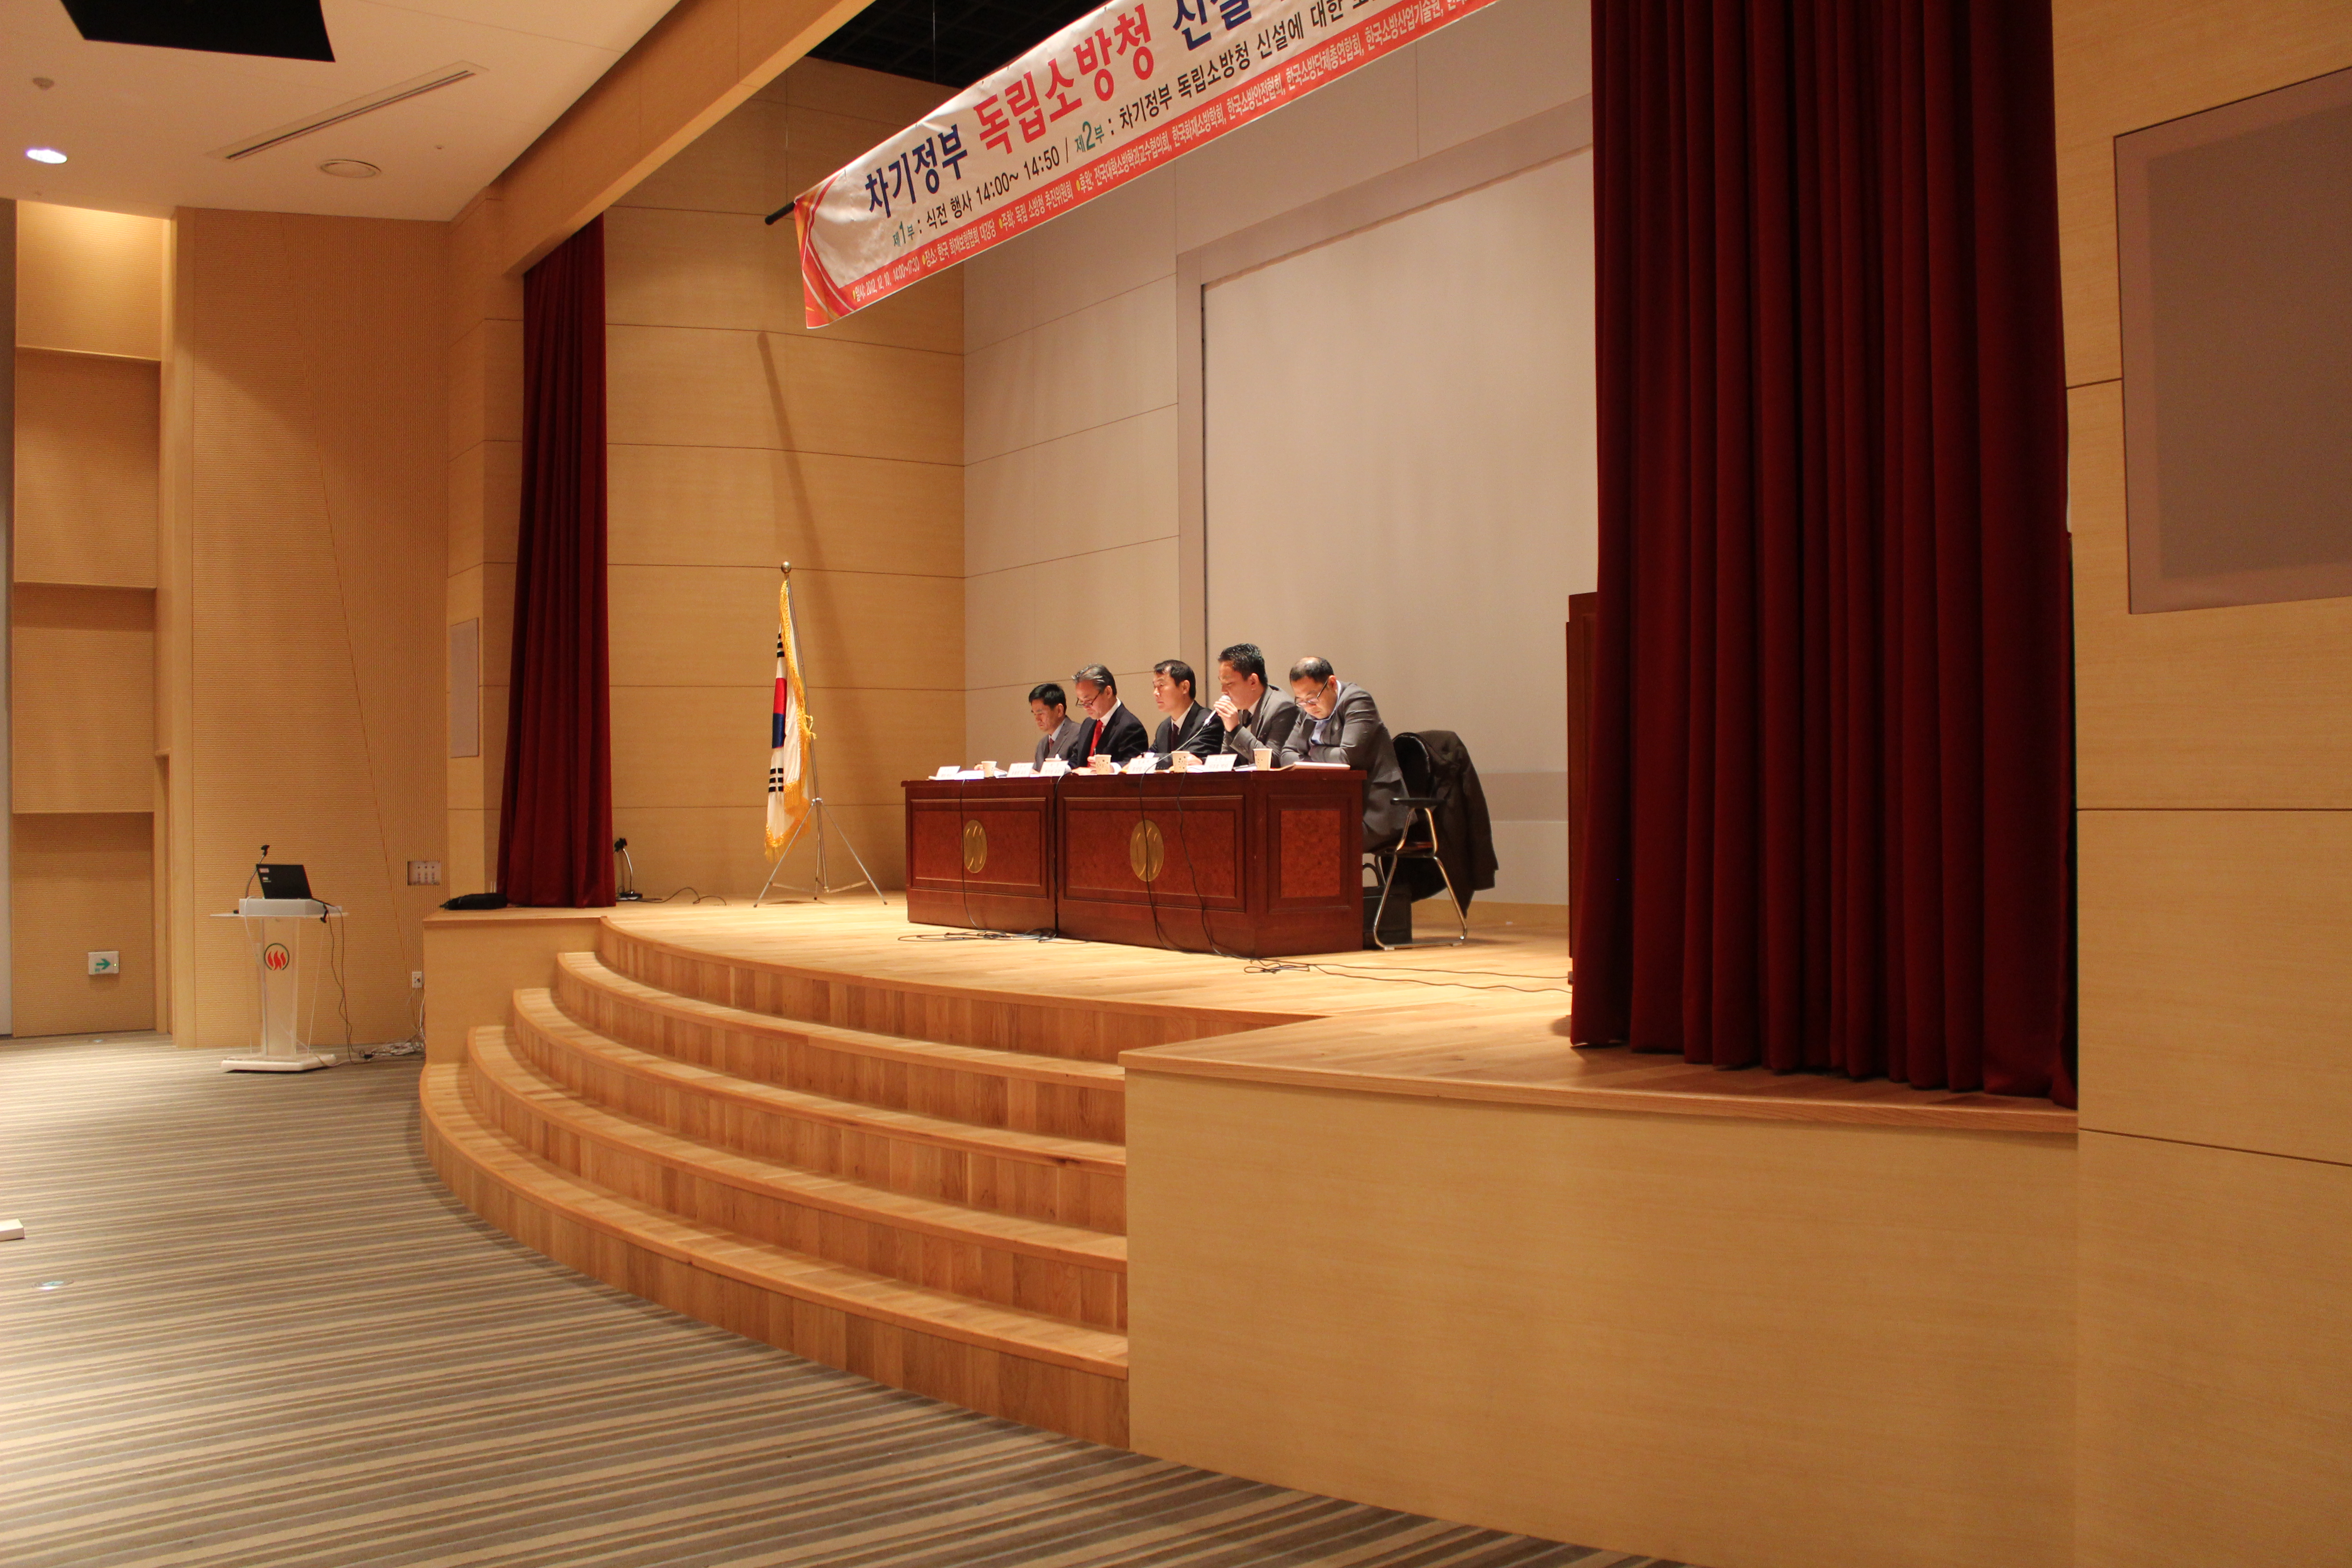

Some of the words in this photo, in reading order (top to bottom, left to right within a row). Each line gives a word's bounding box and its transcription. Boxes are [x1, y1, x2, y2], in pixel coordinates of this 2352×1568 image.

[865, 123, 968, 218] 차기정부
[973, 3, 1154, 154] 독립소방청
[893, 221, 915, 247] 제1부
[926, 203, 948, 229] 식전
[950, 191, 972, 219] 행사
[976, 172, 1018, 205] 14:00~
[1024, 146, 1060, 180] 14:50
[1074, 121, 1104, 152] 제2부
[1119, 83, 1172, 129] 차기정부
[1178, 41, 1250, 98] 독립소방청
[1257, 11, 1304, 59] 신설에
[1310, 0, 1343, 28] 대한
[937, 241, 950, 261] 한국
[949, 226, 980, 255] 화재보험협회
[980, 218, 996, 241] 대강당
[1015, 203, 1028, 224] 독립
[1029, 194, 1045, 218] 소방청
[1045, 180, 1074, 211] 추진위원회
